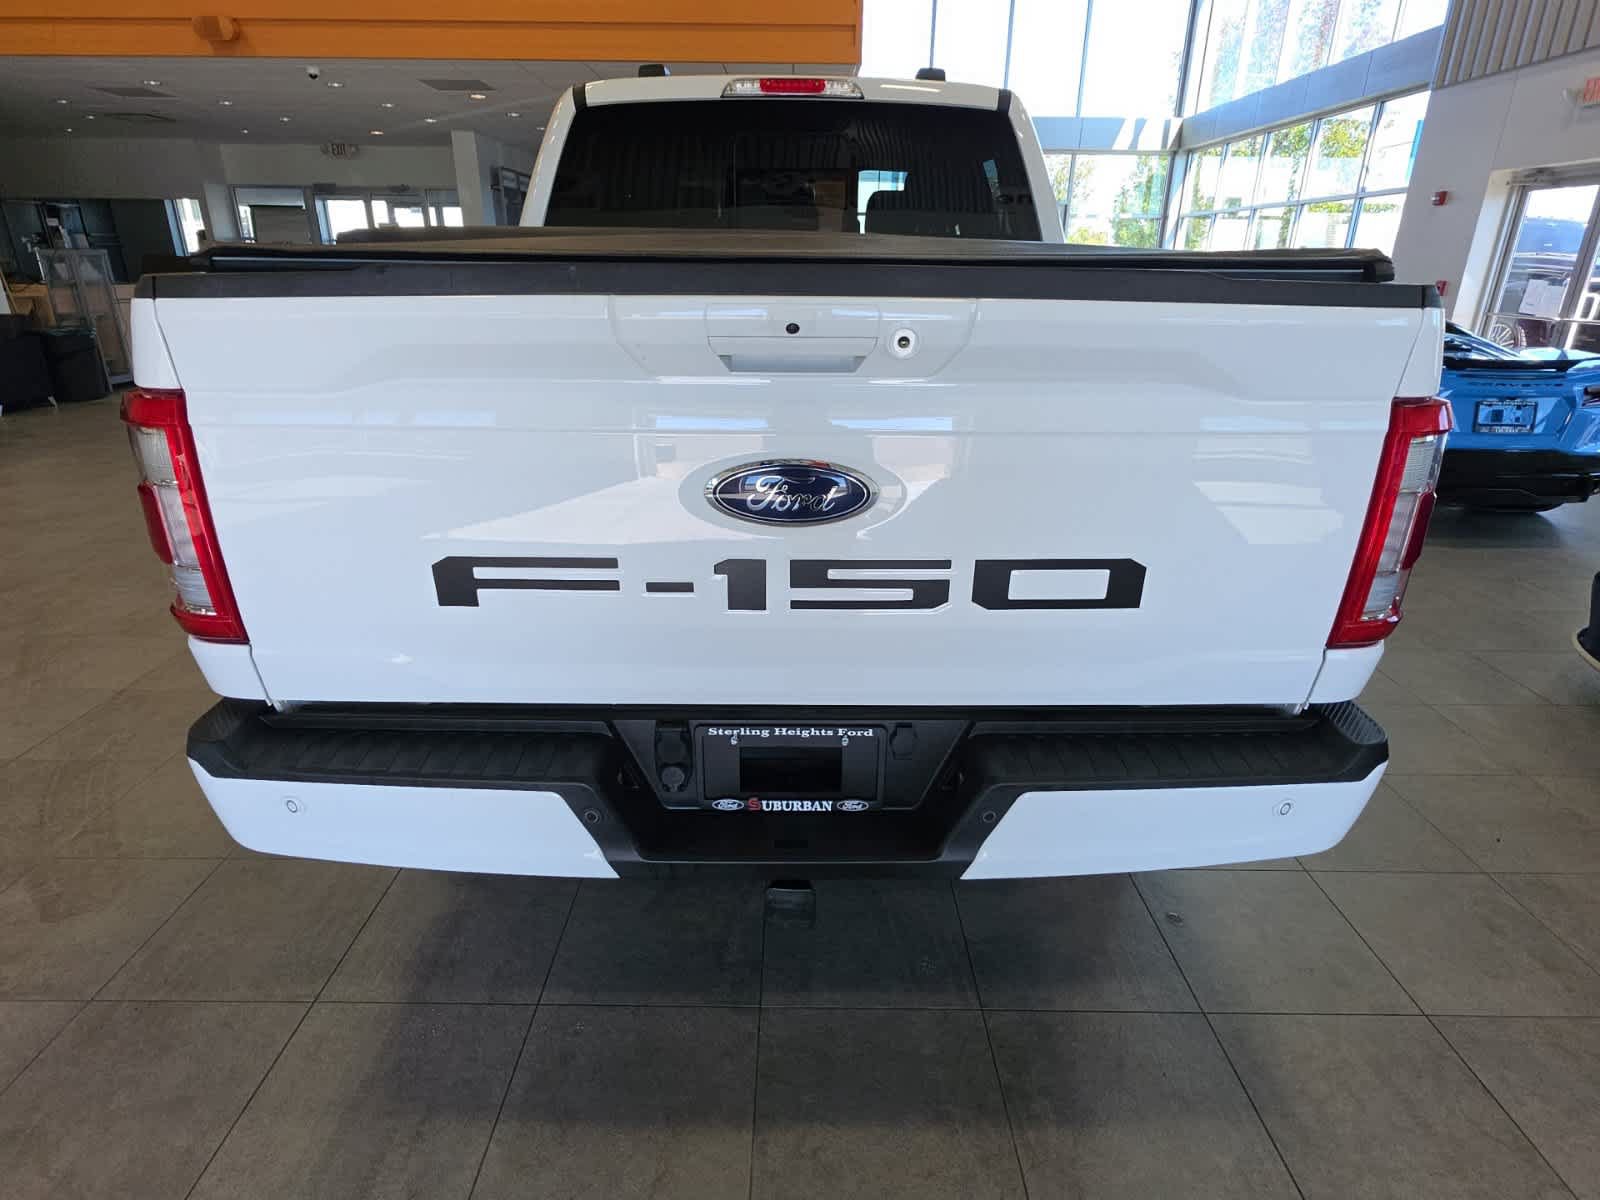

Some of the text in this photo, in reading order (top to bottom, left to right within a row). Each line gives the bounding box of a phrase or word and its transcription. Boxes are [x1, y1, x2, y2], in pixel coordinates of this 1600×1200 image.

[746, 475, 838, 511] Ford
[431, 556, 1148, 611] F-150
[708, 727, 874, 738] Sterling Heights Ford
[748, 797, 832, 811] SUBURBAN
